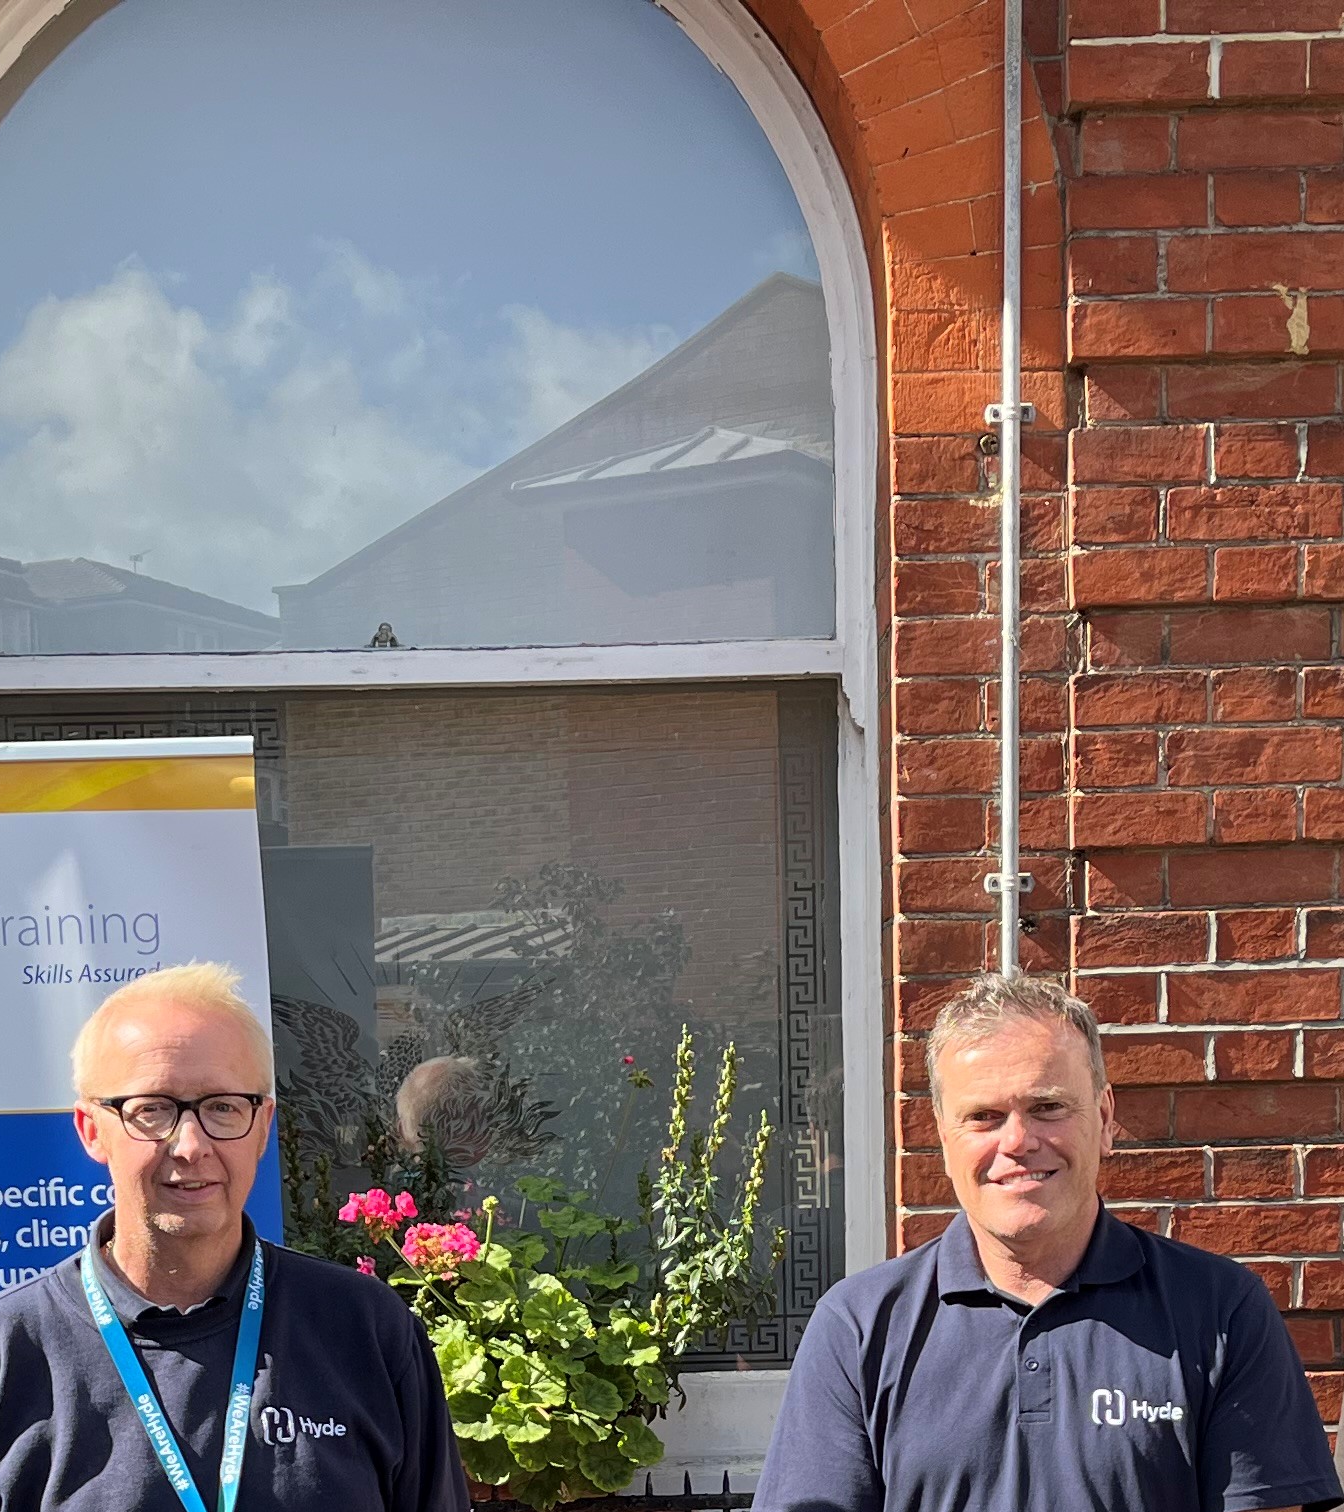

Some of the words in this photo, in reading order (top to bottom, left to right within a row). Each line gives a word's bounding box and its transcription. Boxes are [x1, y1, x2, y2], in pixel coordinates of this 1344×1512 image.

[22, 964, 73, 985] Skills
[1131, 1400, 1184, 1423] Hyde
[223, 1382, 251, 1485] #WeAreHyde
[298, 1416, 347, 1439] Hyde
[137, 1393, 190, 1491] #WeAreHyde
